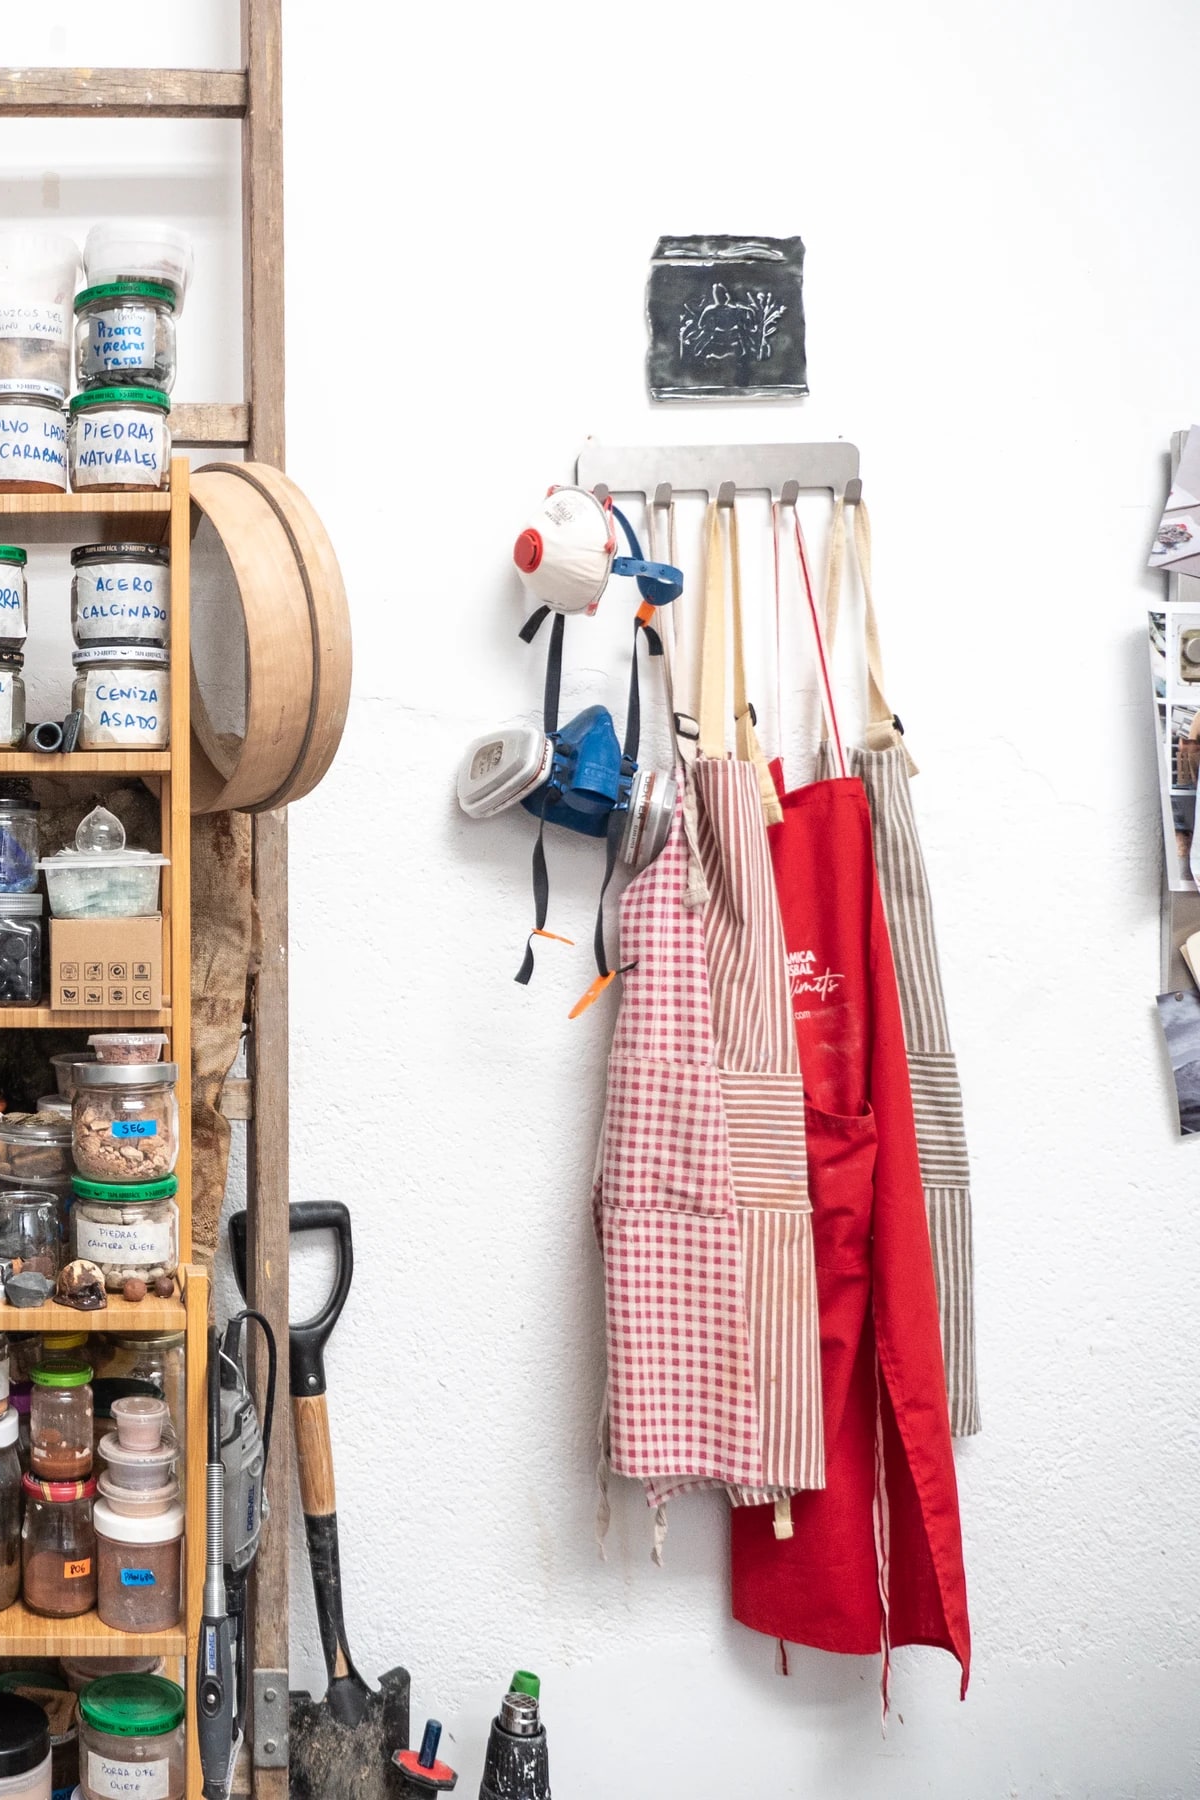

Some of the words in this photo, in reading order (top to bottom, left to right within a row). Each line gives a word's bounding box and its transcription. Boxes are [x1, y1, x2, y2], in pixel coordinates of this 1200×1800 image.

[97, 321, 142, 338] Pizarra
[93, 344, 100, 357] y
[103, 357, 143, 366] raras
[84, 422, 154, 443] PIEDRAS
[79, 448, 157, 470] NATURALES
[96, 577, 154, 593] ACERO
[82, 605, 167, 622] CALCINADO
[95, 686, 159, 703] CENIZA
[99, 711, 158, 731] ASADO
[540, 740, 550, 771] DEXT
[134, 990, 150, 1001] CE
[99, 1228, 137, 1239] PIEDRAS
[246, 1485, 255, 1531] DREMEL
[208, 1631, 216, 1670] DREMEL
